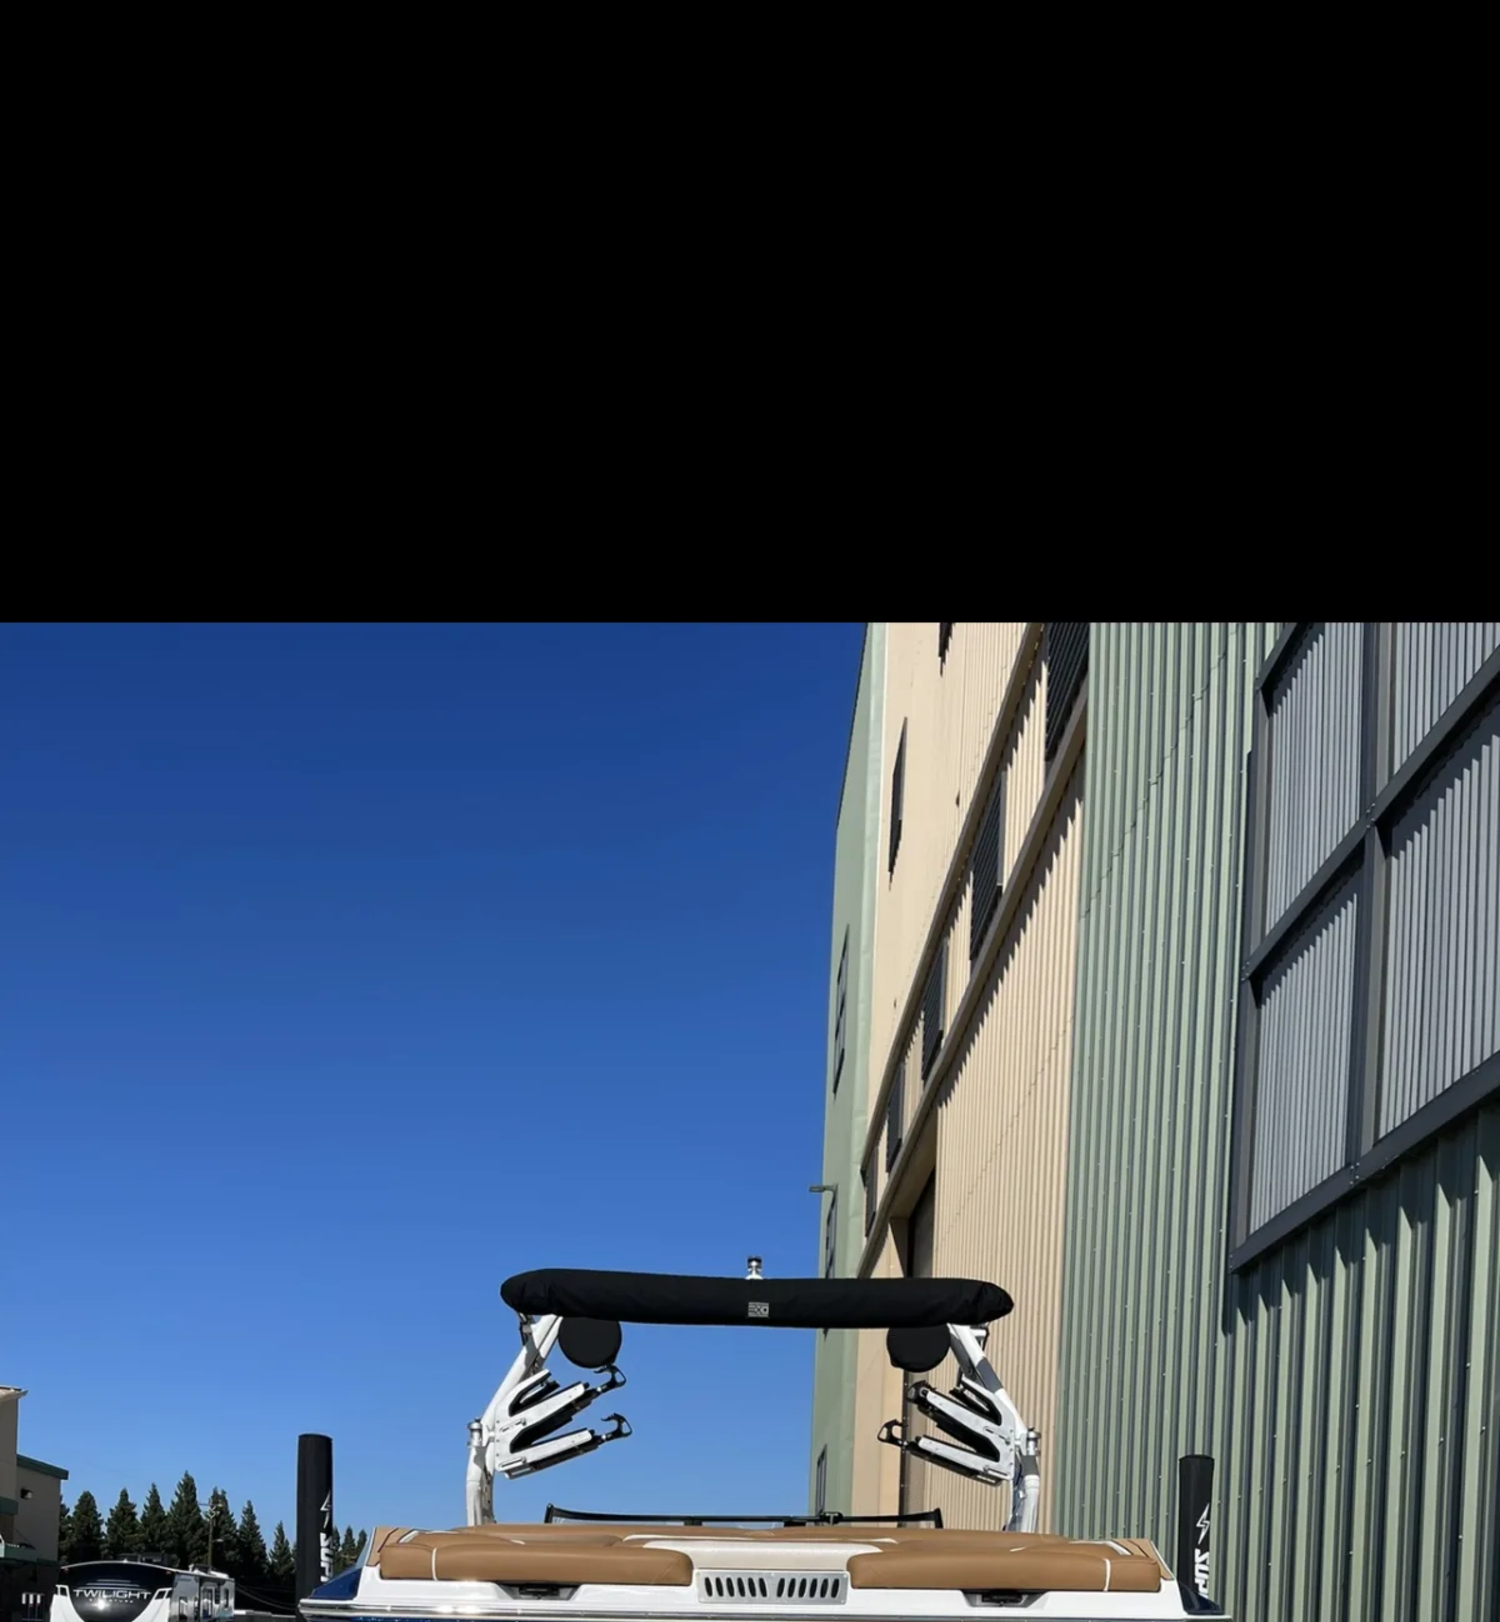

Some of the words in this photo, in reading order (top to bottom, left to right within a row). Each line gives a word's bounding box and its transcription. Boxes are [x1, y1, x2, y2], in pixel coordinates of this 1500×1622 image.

[320, 1532, 333, 1583] SUP
[1194, 1548, 1210, 1600] SUP
[73, 1589, 152, 1600] TWILIGHT
